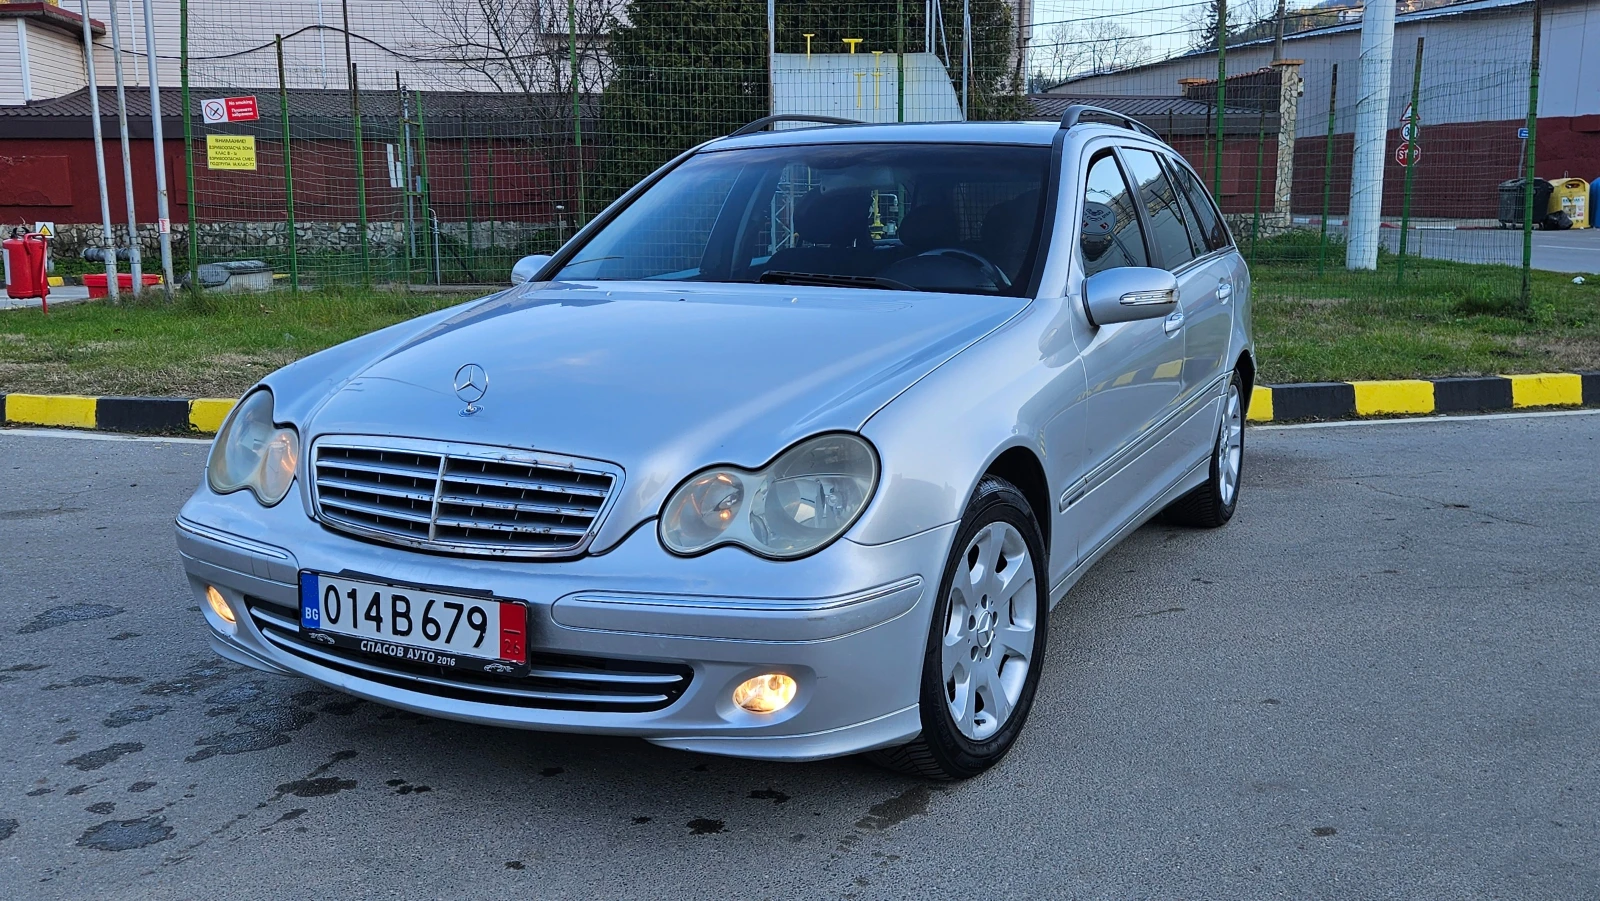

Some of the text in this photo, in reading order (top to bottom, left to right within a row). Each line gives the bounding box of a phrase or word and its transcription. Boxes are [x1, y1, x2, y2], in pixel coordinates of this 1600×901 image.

[1398, 150, 1418, 159] STP
[305, 607, 319, 621] BG
[360, 640, 456, 666] СПАСОВ АУТО 2016
